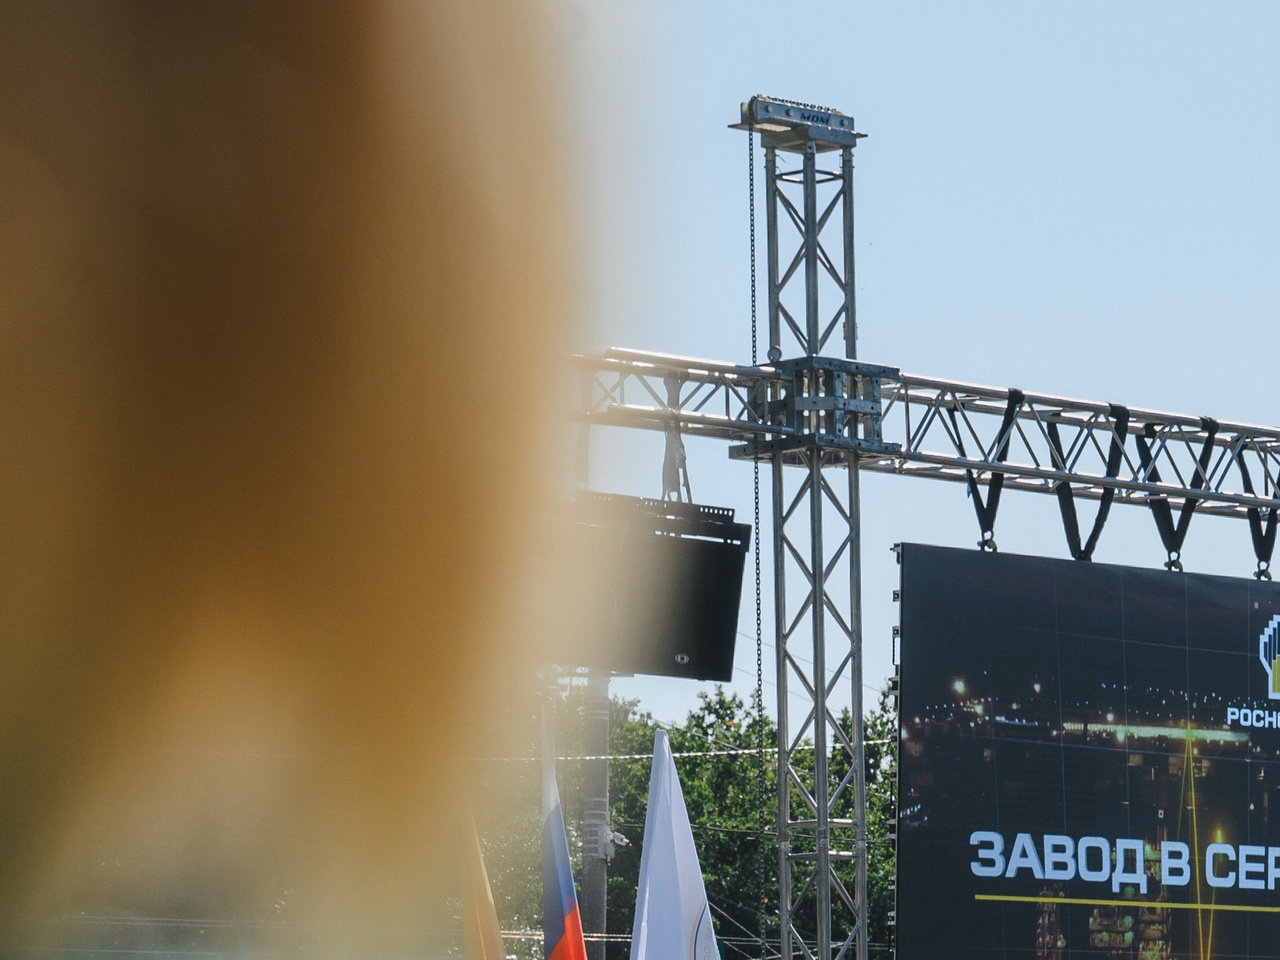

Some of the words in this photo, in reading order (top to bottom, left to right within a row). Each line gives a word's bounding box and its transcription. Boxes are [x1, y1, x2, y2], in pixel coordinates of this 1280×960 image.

[801, 113, 831, 125] MDM
[969, 831, 1148, 893] ЗАВОД
[1160, 842, 1191, 886] В
